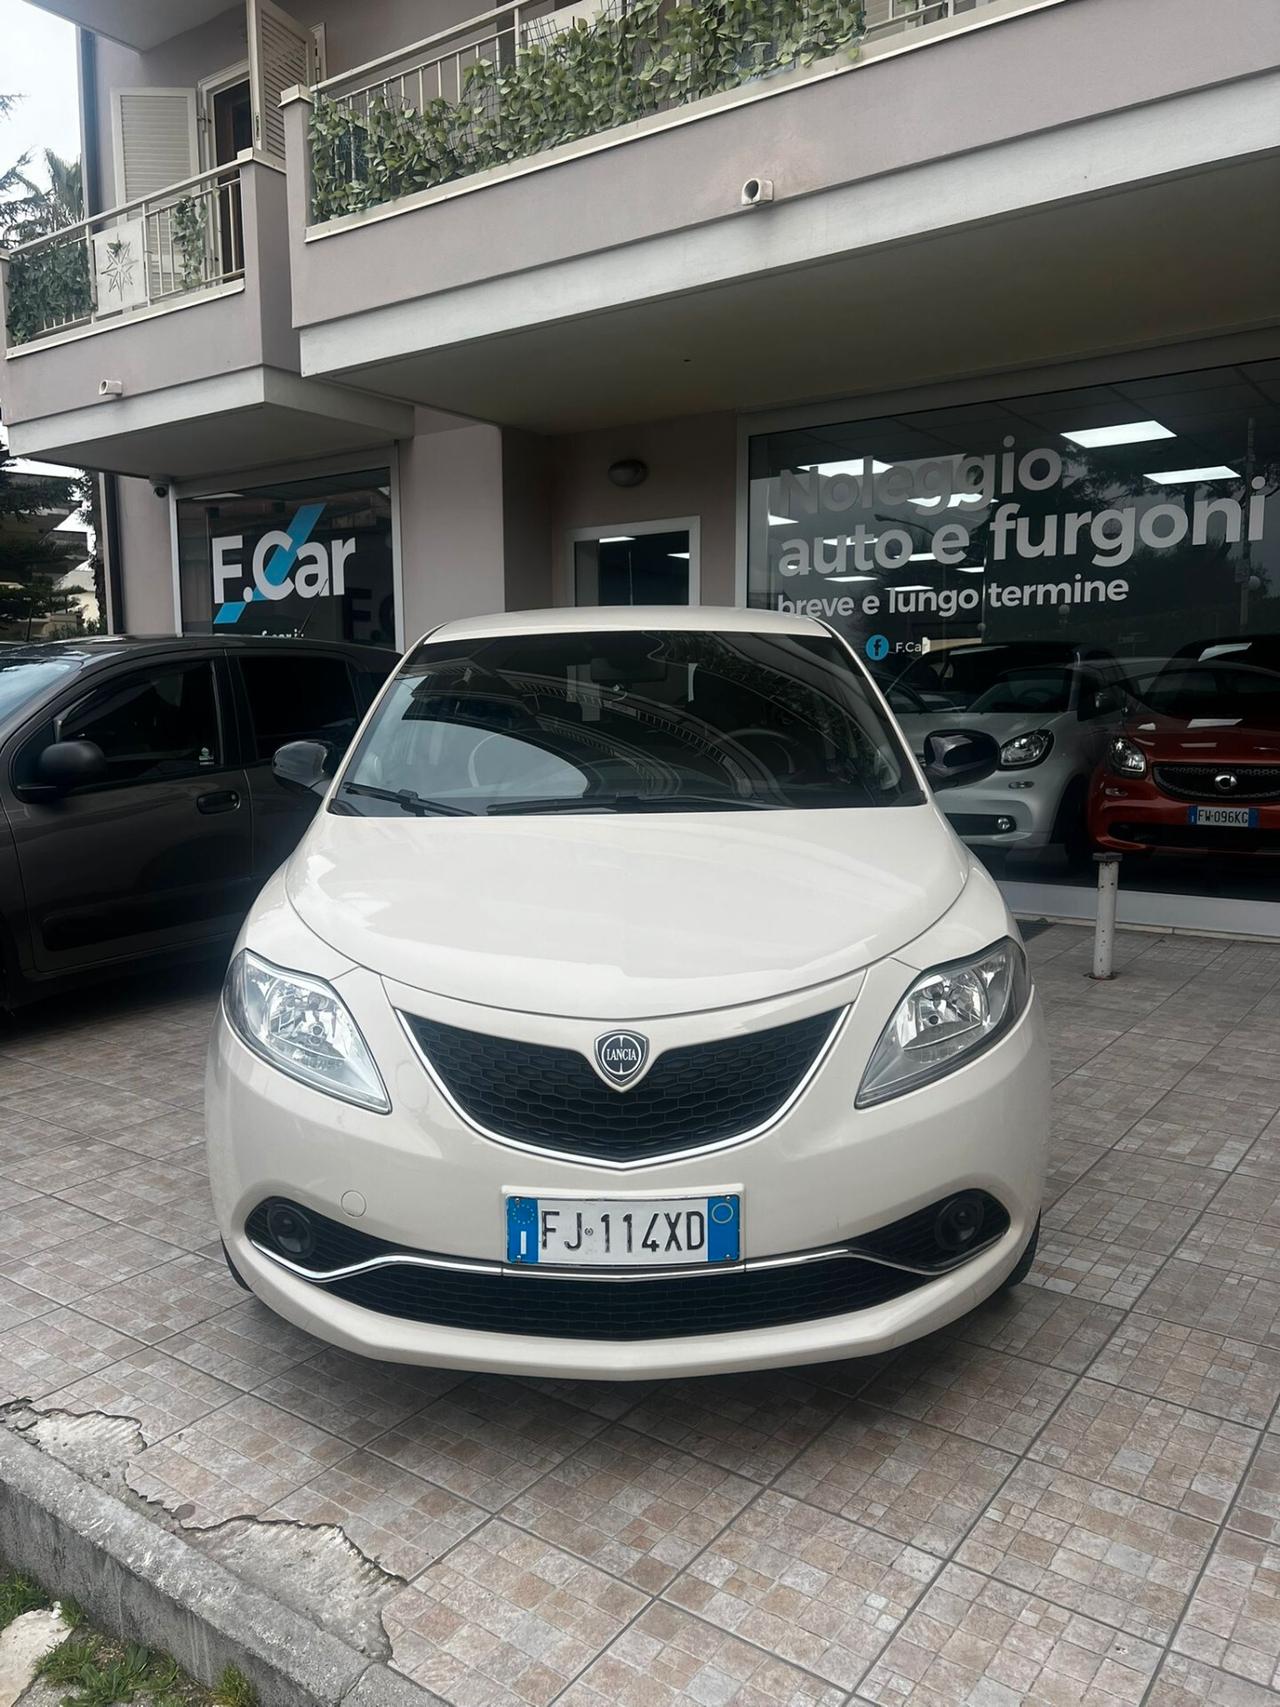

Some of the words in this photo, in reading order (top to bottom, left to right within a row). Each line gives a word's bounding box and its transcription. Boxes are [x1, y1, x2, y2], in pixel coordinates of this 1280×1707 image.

[779, 435, 1062, 516] Noleggio
[778, 523, 914, 577] auto
[931, 523, 970, 565] e
[989, 475, 1266, 568] furgoni
[211, 530, 356, 604] F.Car
[778, 594, 855, 618] breve
[861, 595, 880, 615] e
[889, 586, 979, 618] lungo
[988, 573, 1130, 608] termine
[895, 641, 928, 653] F.Ca
[606, 1048, 637, 1061] LANCIA
